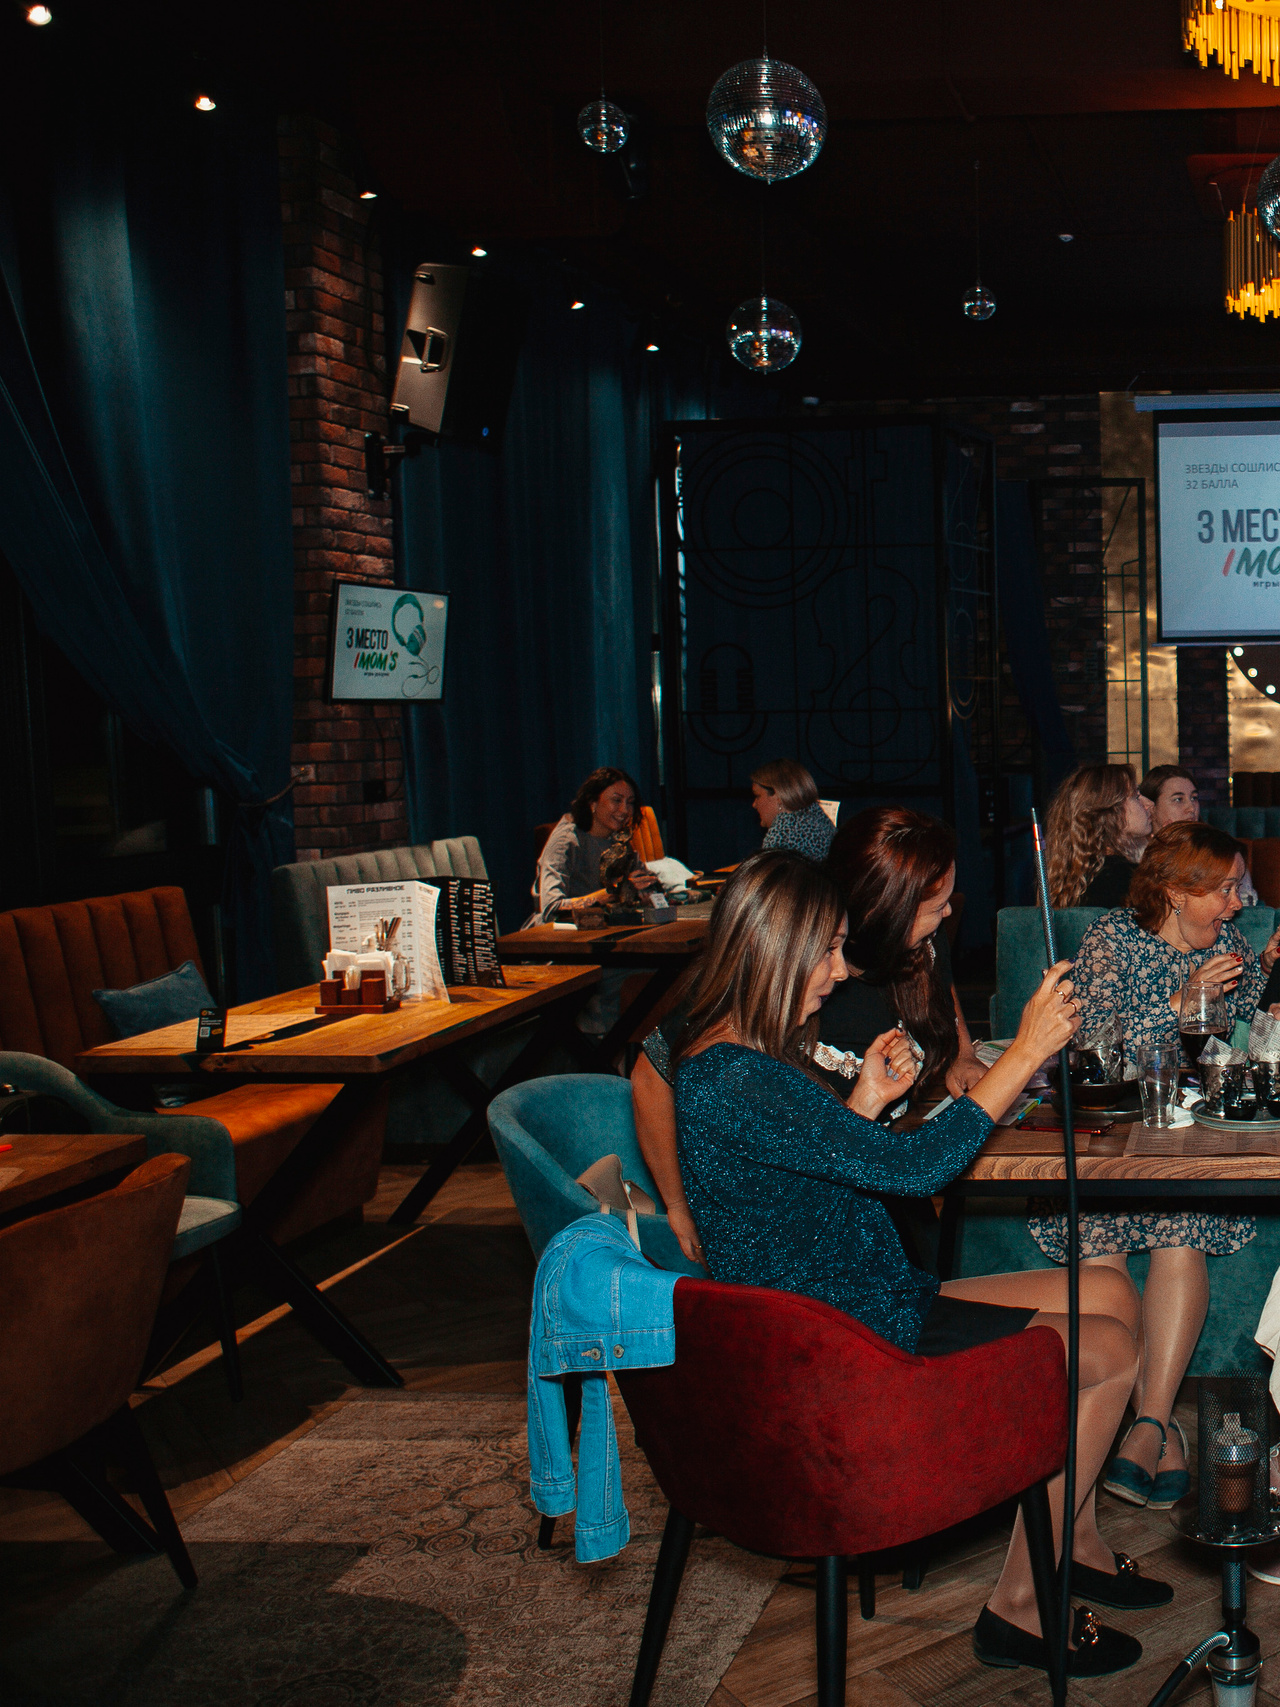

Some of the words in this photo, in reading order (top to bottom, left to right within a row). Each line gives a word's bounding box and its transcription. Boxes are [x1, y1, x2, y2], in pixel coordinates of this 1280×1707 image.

[1185, 463, 1229, 475] ЗВЕЗДЫ
[1186, 480, 1198, 490] 32
[1201, 479, 1239, 489] БАЛЛА
[1197, 509, 1214, 544] 3
[1253, 580, 1280, 589] игры
[346, 627, 354, 649] 3
[355, 628, 389, 650] МЕСТО
